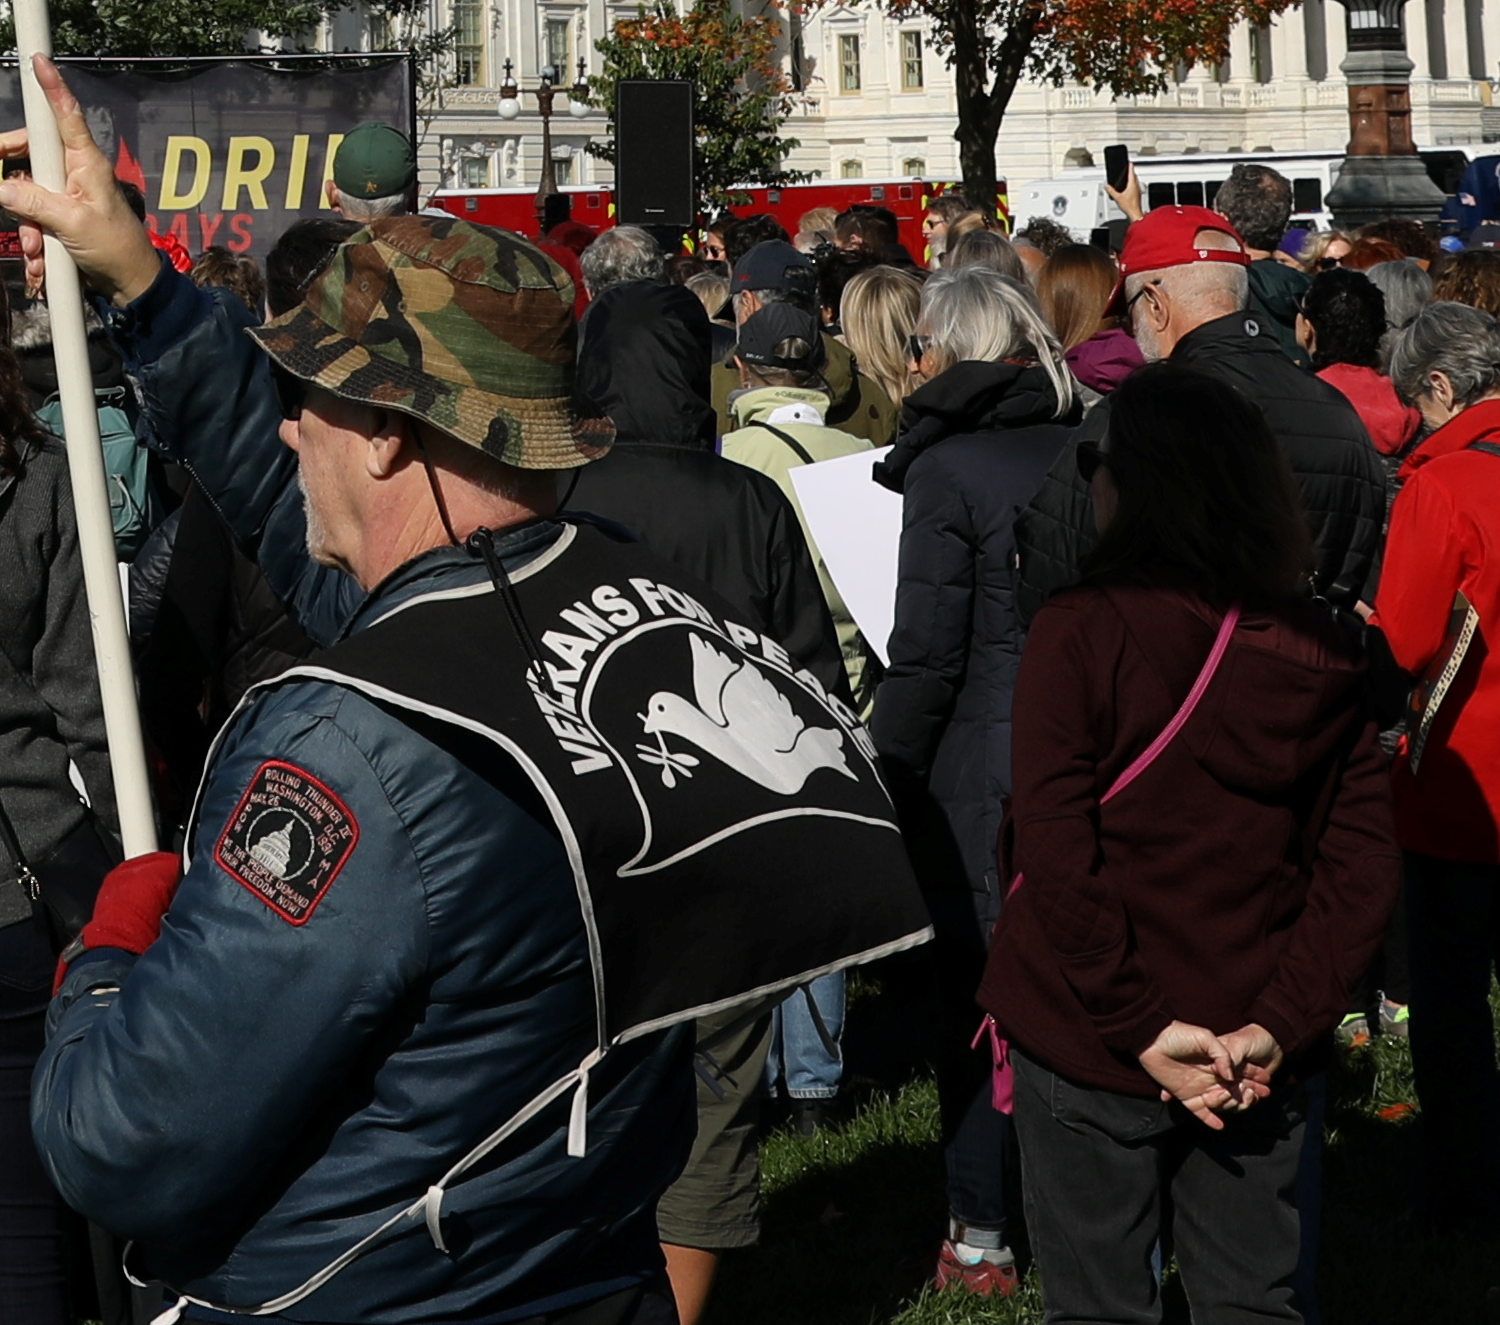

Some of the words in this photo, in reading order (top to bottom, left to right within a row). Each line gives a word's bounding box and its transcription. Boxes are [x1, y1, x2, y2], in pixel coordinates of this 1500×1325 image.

[265, 769, 301, 789] ROLLING
[305, 785, 343, 824] THUNDER
[268, 796, 281, 807] 26
[219, 846, 239, 869] THEIR
[238, 864, 276, 899] FREEDOM
[276, 895, 301, 917] NOW!
[233, 845, 247, 860] THE
[248, 859, 277, 884] PEOPLE
[275, 882, 310, 908] DEMAND
